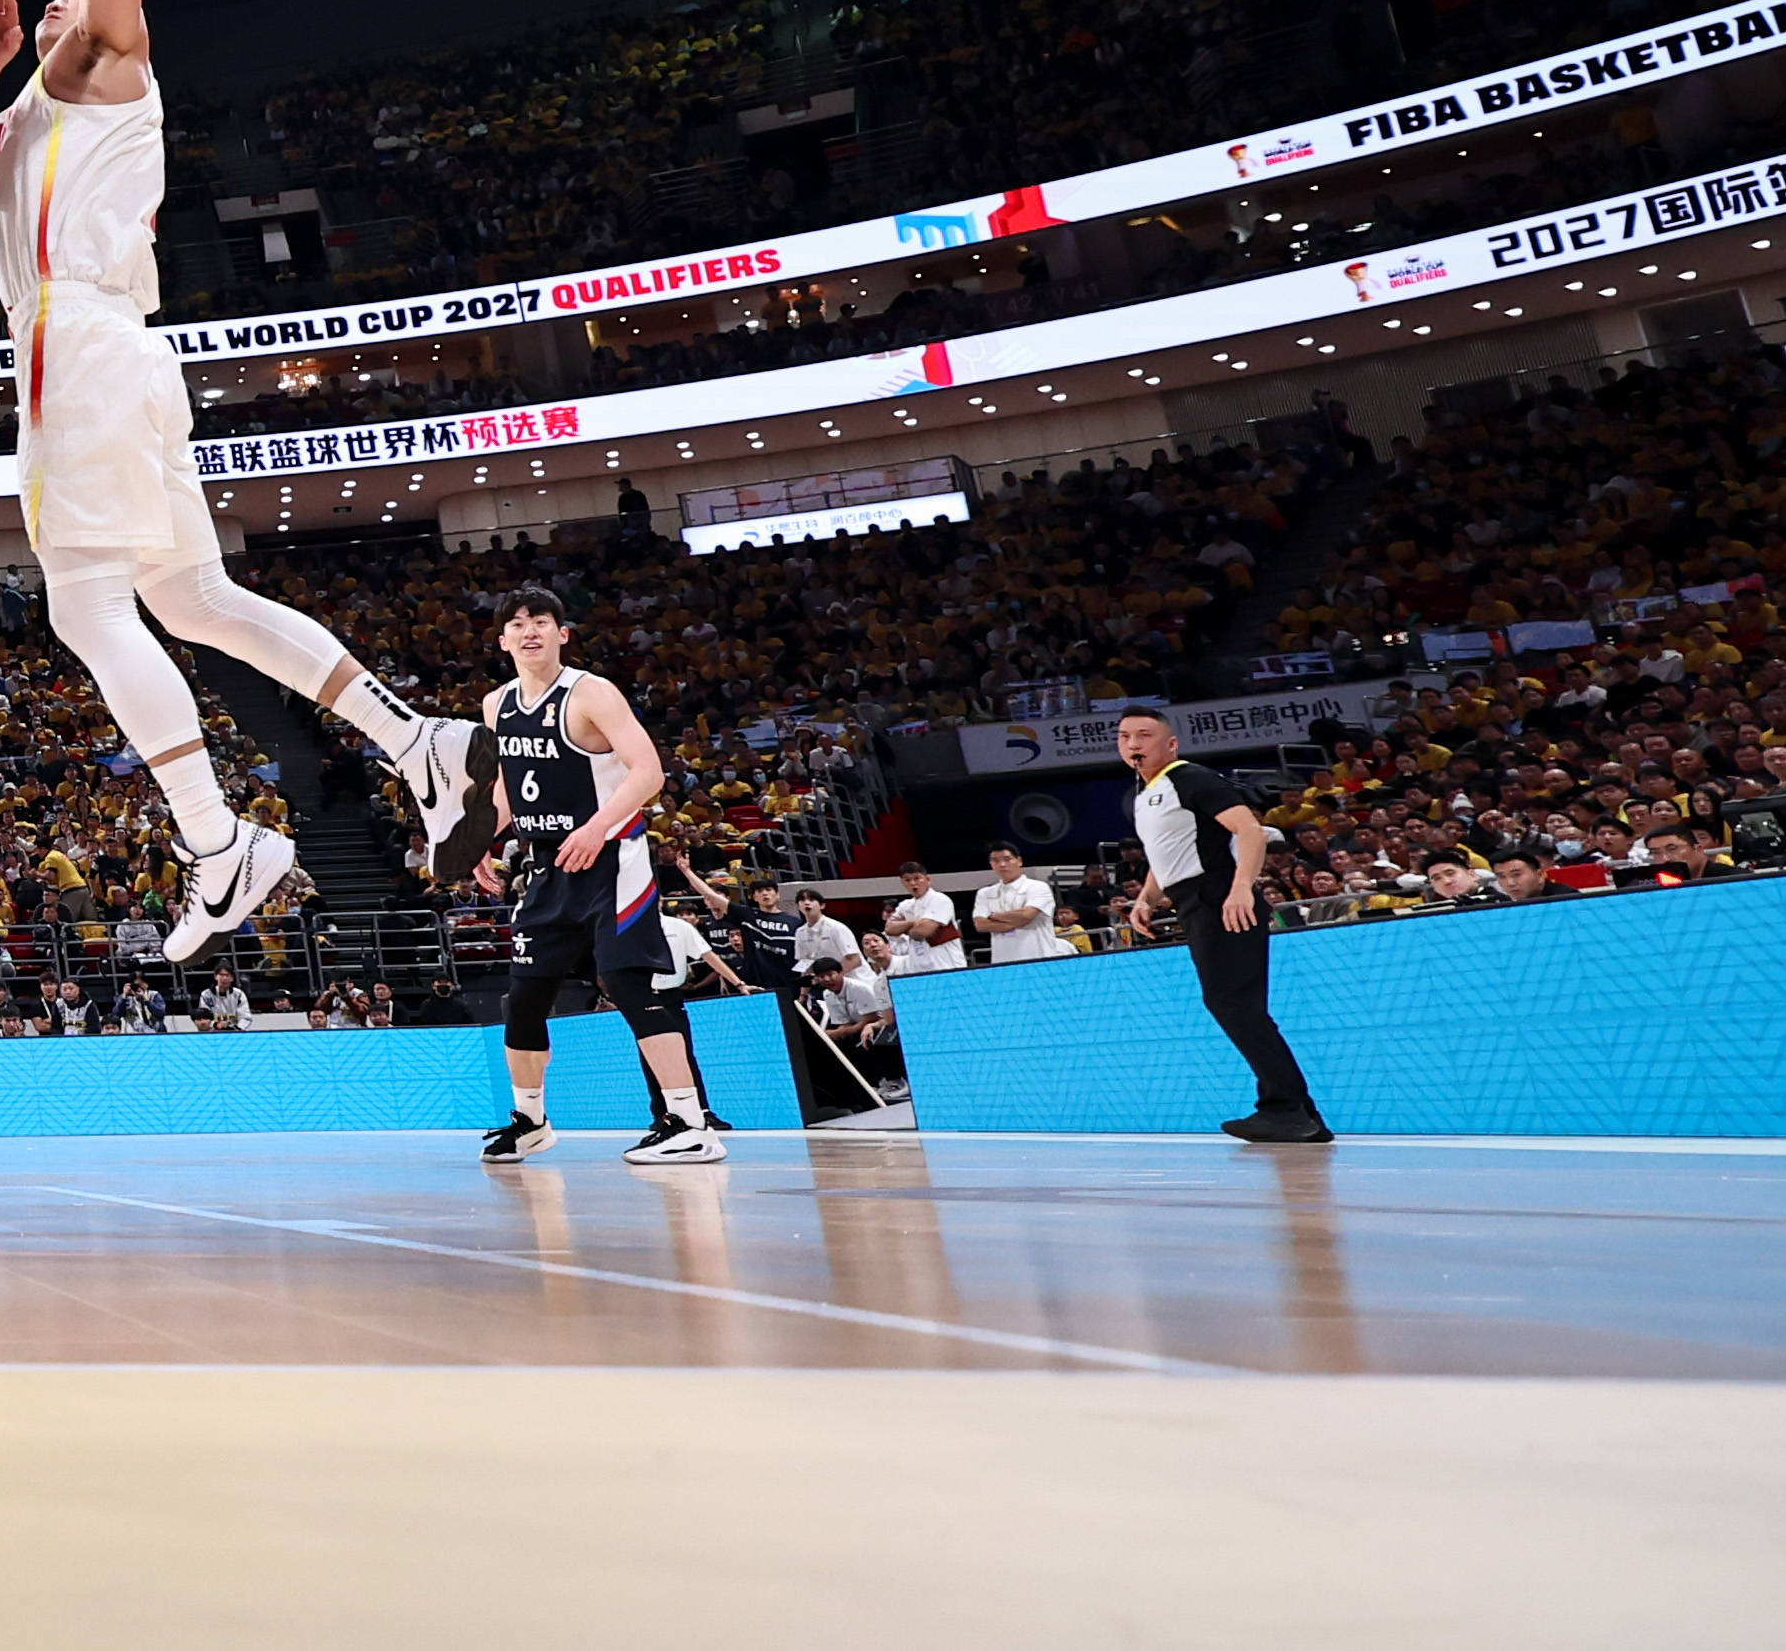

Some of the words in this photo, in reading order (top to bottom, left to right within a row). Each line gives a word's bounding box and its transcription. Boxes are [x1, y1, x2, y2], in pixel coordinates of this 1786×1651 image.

[1343, 95, 1469, 148] FIBA
[1388, 266, 1422, 278] WORLD
[1425, 261, 1444, 270] CUP
[1389, 269, 1448, 288] QUALIFIERS
[224, 316, 349, 350] WORLD
[358, 305, 434, 335] CUP
[442, 288, 541, 324] 2027
[551, 248, 782, 310] QUALIFIERS
[193, 405, 580, 476] 篮联篮球世界杯预选赛
[1050, 718, 1122, 745] 华熙
[1187, 697, 1343, 736] 润百颜中心
[497, 735, 560, 759] KOREA
[520, 769, 540, 802] 6
[519, 813, 574, 832] 하나은행
